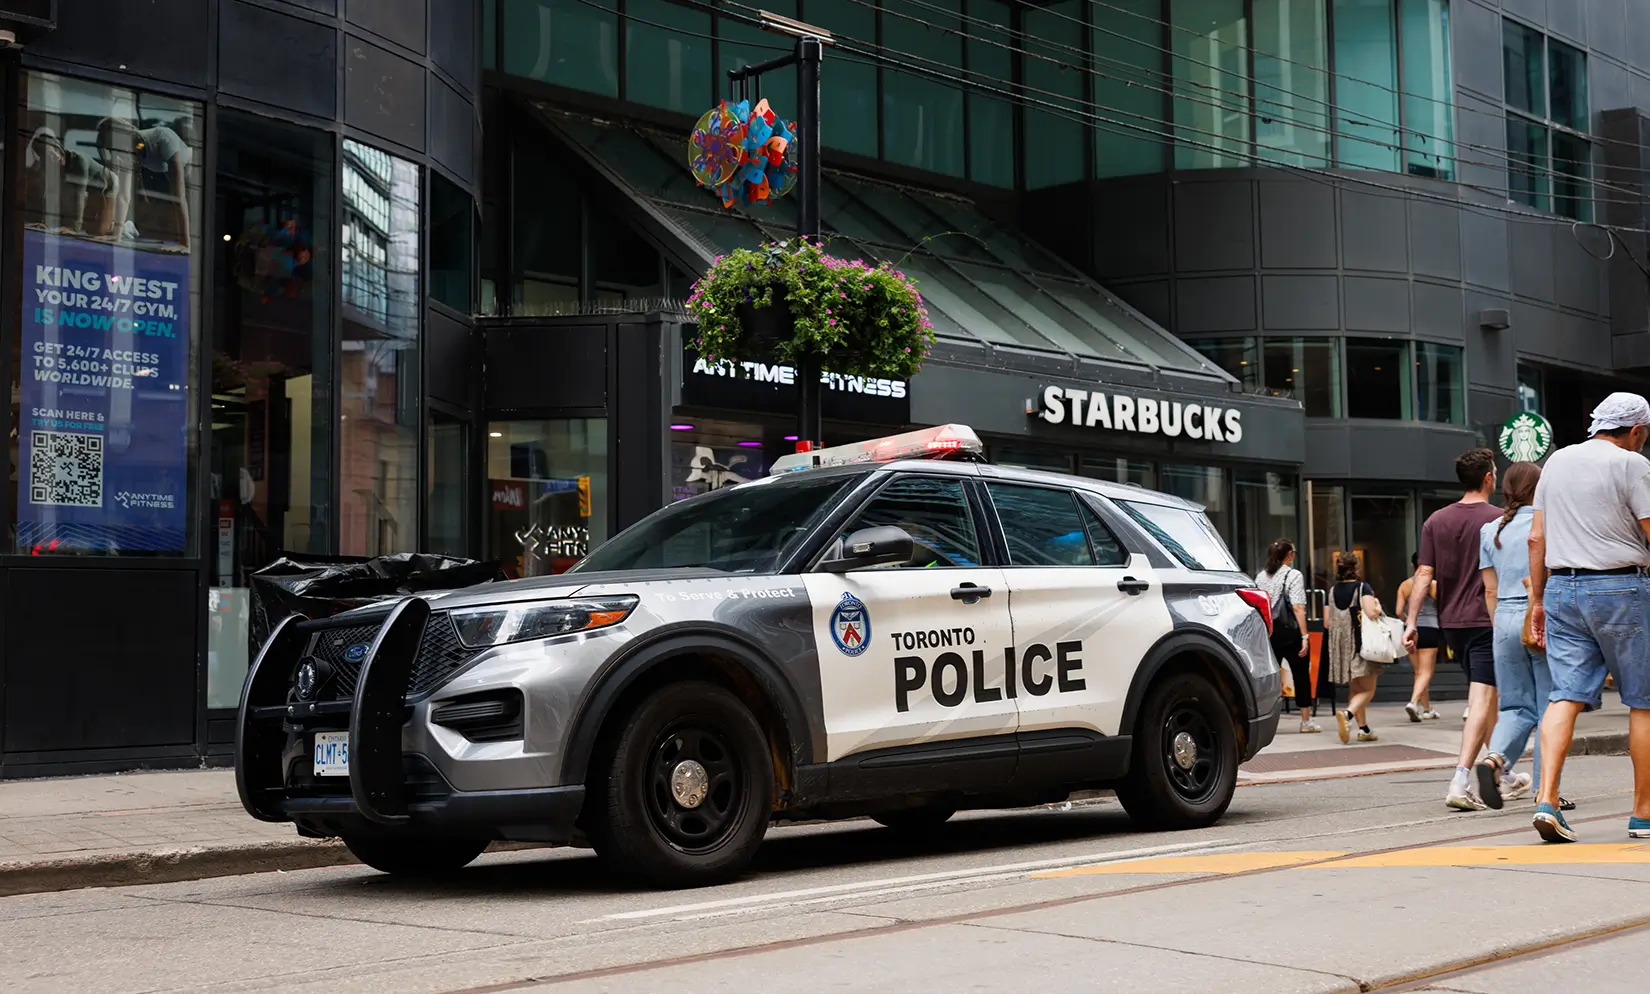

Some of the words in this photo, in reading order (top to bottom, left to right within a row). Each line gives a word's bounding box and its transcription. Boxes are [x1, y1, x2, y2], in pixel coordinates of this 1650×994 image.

[36, 265, 101, 291] KING
[104, 274, 178, 300] WEST
[35, 289, 87, 308] YOUR
[91, 296, 131, 313] 24/7
[133, 302, 178, 320] GYM,
[34, 308, 54, 325] IS
[58, 311, 115, 331] NOW
[116, 317, 176, 338] OPEN.
[33, 342, 64, 355] GET
[66, 345, 99, 358] 24/7
[102, 349, 159, 364] ACCESS
[33, 355, 55, 367] TO
[58, 359, 109, 373] 5,600+
[33, 370, 135, 390] WORLDWIDE.
[32, 407, 64, 418] SCAN
[66, 411, 95, 421] HERE
[97, 413, 105, 422] &
[32, 418, 51, 427] TRY
[51, 419, 63, 428] US
[64, 421, 83, 429] FOR
[1043, 385, 1243, 444] STARBUCKS
[131, 493, 174, 502] ANYTIME
[655, 592, 676, 602] To
[678, 590, 724, 602] Serve
[727, 588, 740, 600] &
[742, 587, 796, 599] Protect
[891, 627, 975, 651] TORONTO
[894, 641, 1086, 713] POLICE
